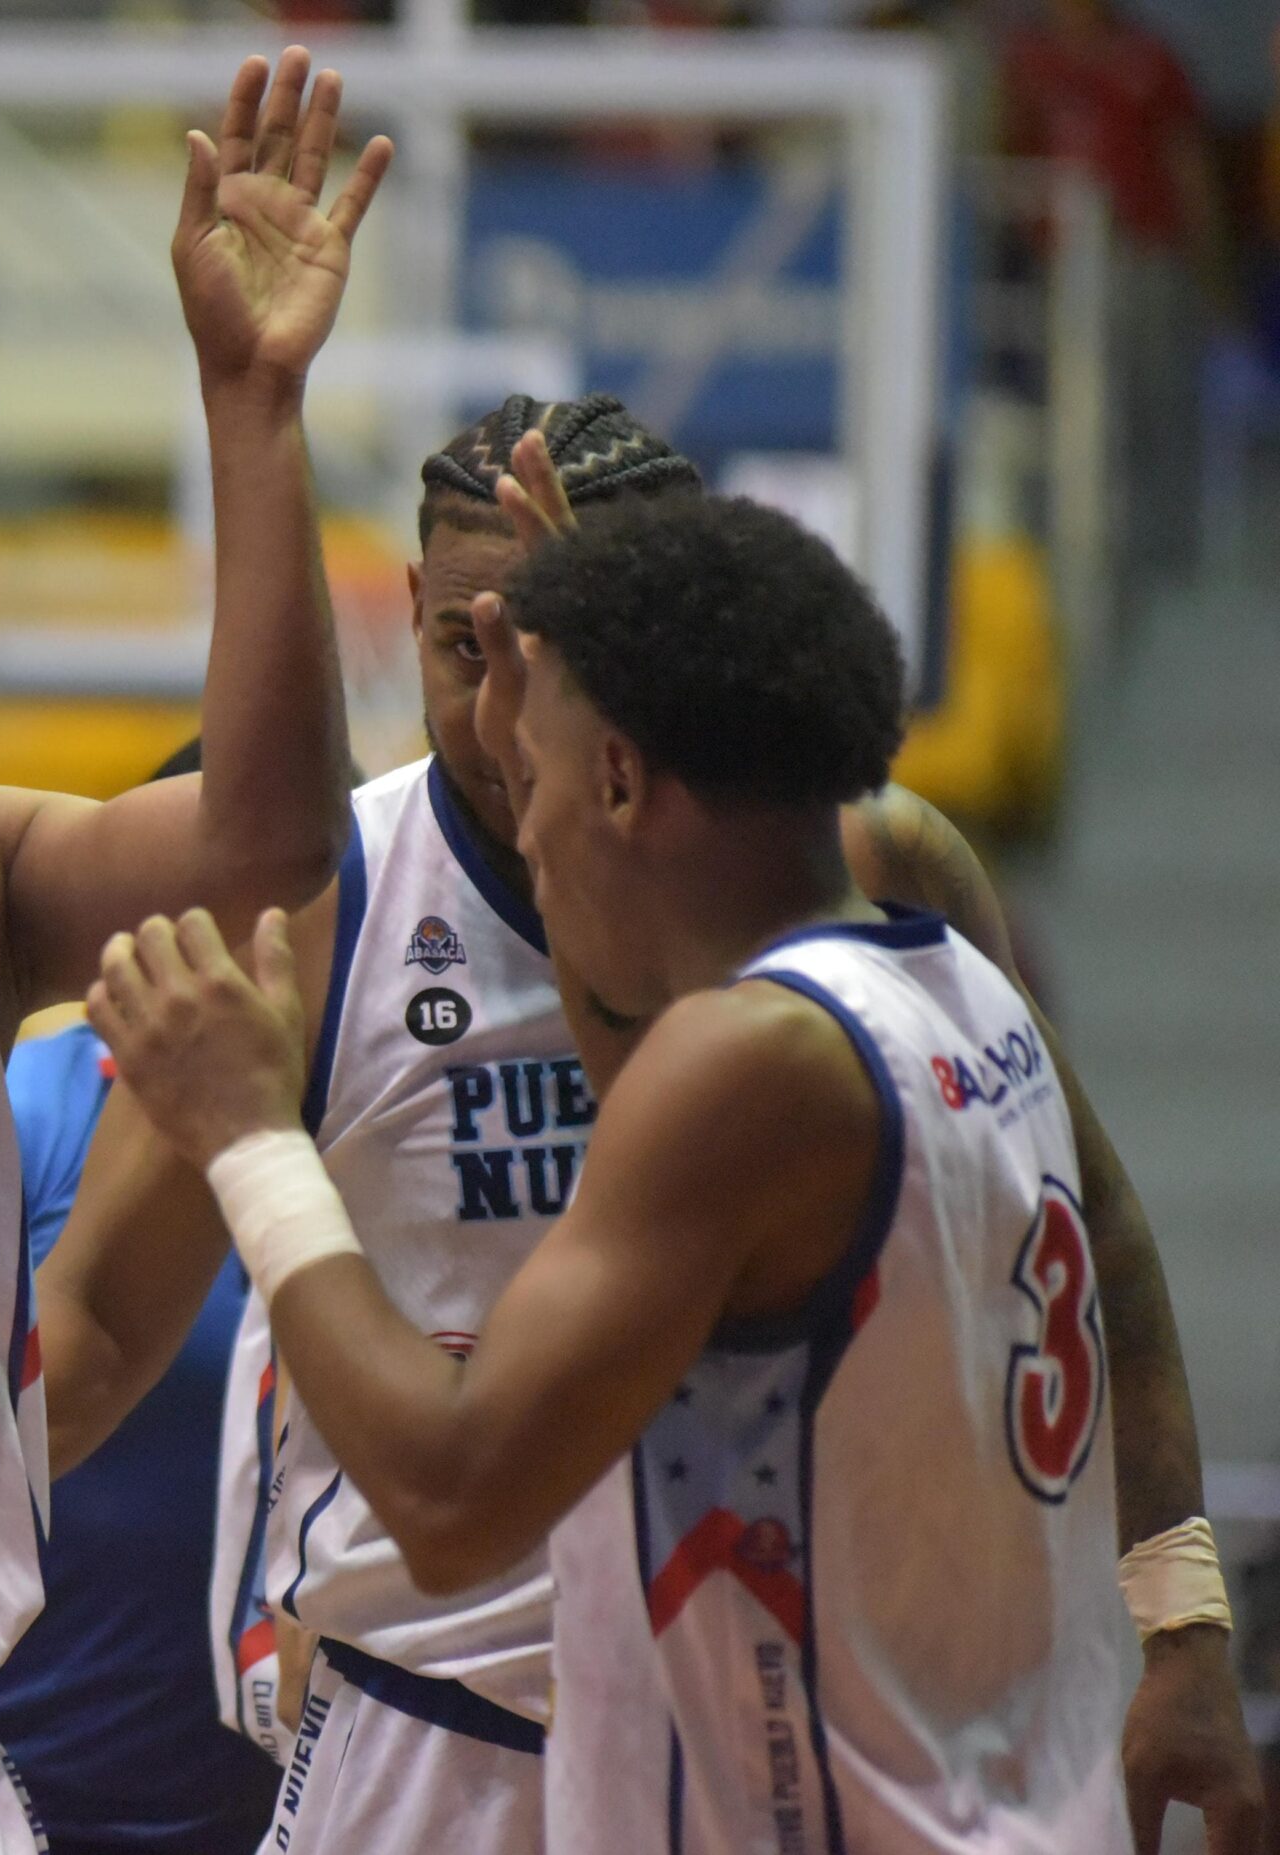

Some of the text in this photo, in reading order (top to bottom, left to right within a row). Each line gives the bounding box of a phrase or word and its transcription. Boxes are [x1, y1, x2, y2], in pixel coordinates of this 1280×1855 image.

[406, 944, 466, 965] ABASACA
[419, 1000, 458, 1031] 16
[1004, 1174, 1106, 1505] 3
